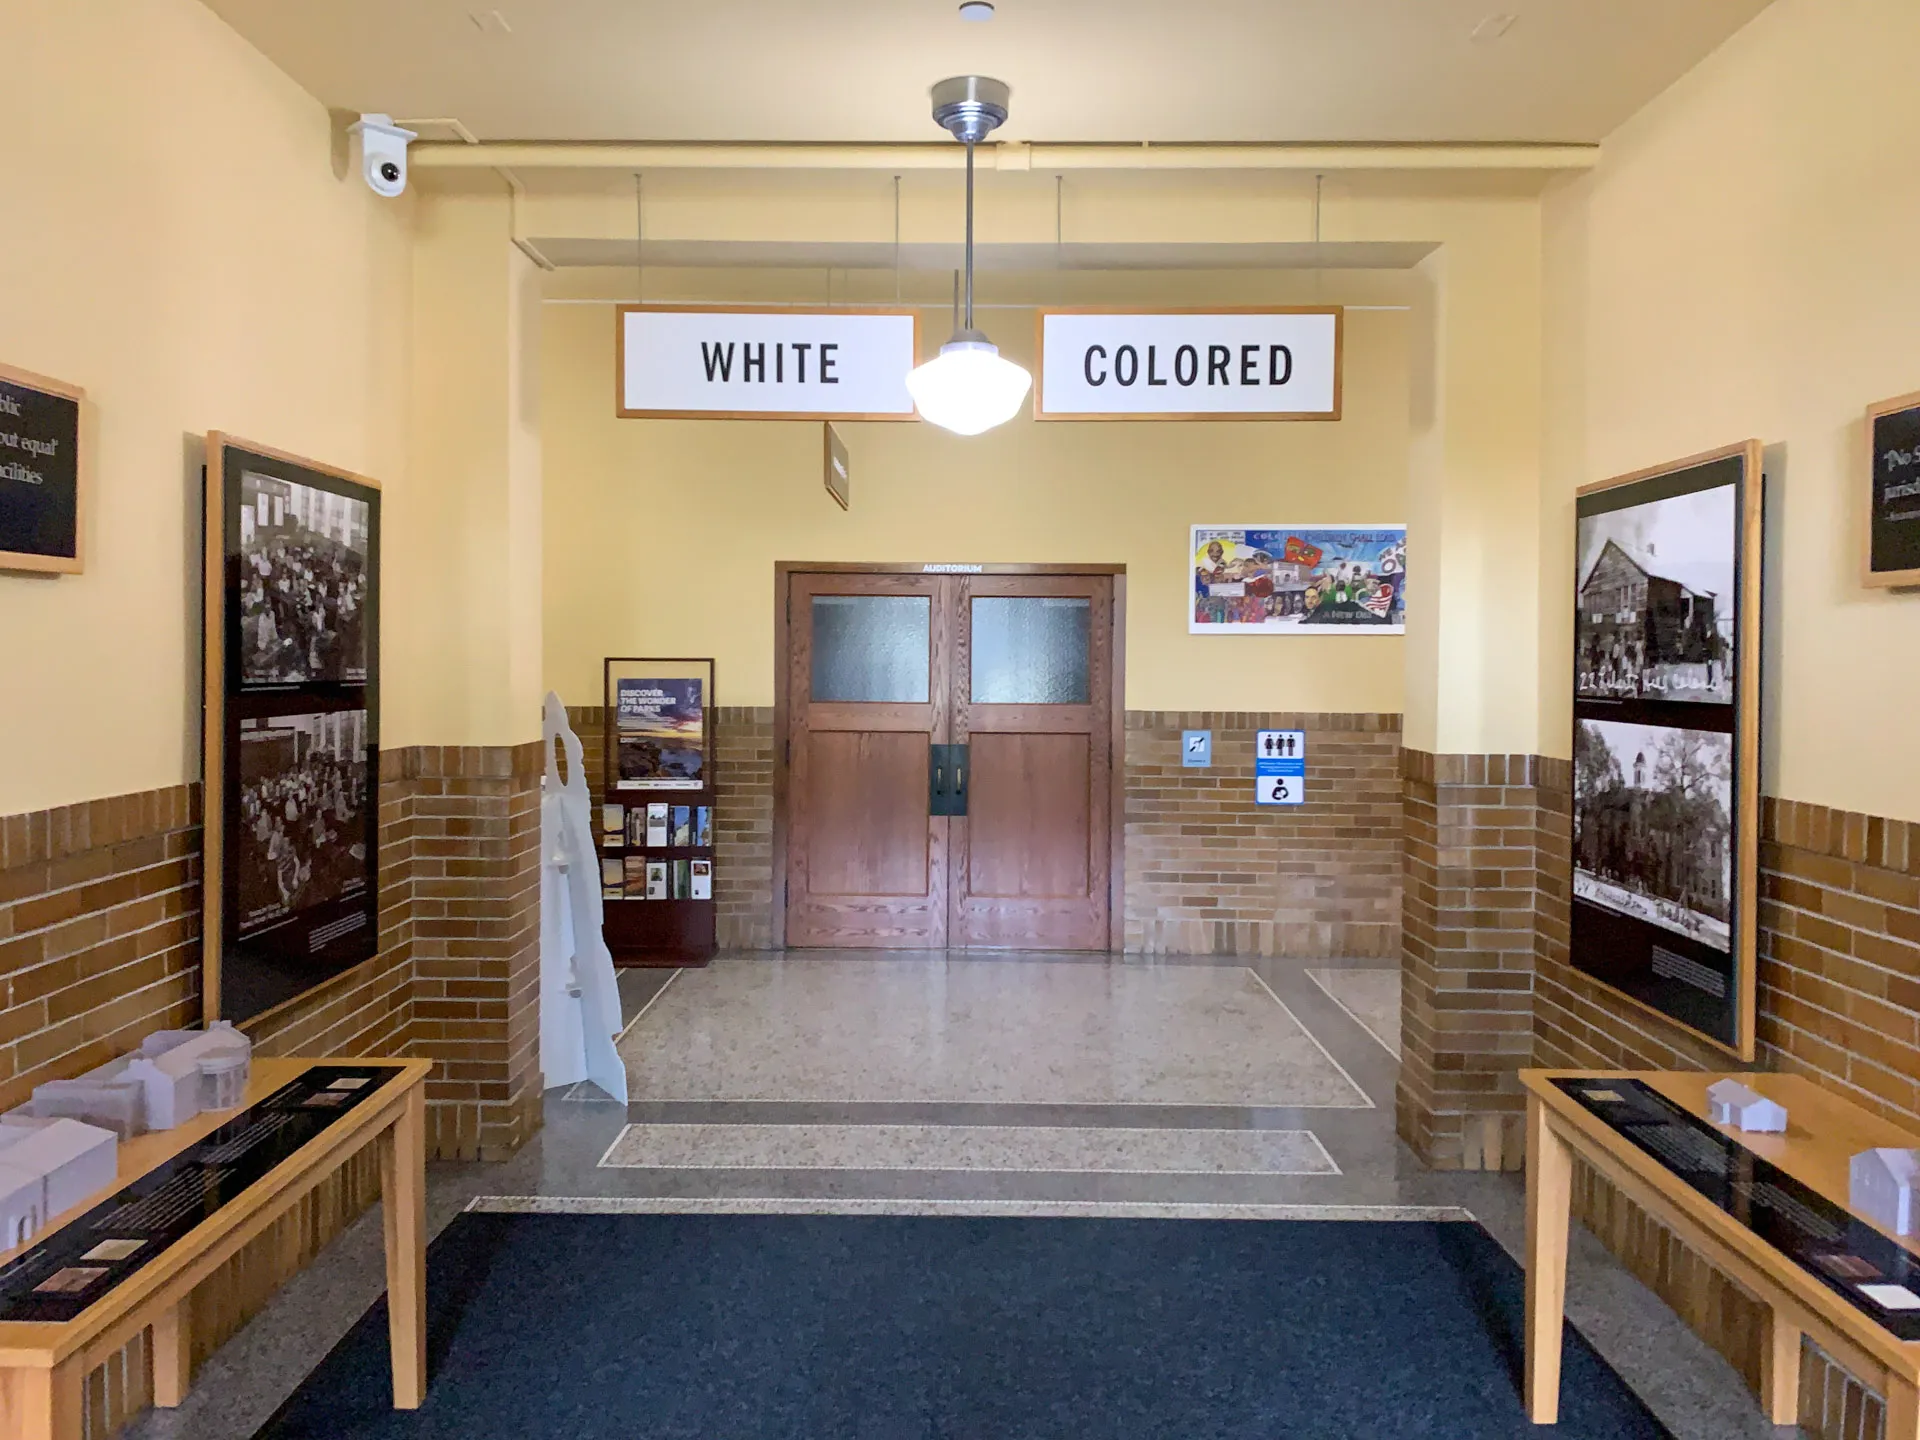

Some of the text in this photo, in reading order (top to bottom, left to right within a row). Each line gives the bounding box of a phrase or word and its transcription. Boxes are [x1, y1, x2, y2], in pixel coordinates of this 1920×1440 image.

[701, 341, 839, 383] WHITE
[1084, 344, 1293, 387] COLORED
[922, 564, 983, 573] AUDITORIUM
[620, 689, 664, 697] DISCOVER
[620, 697, 677, 705] THE WONDER
[620, 705, 661, 713] OF PARKS
